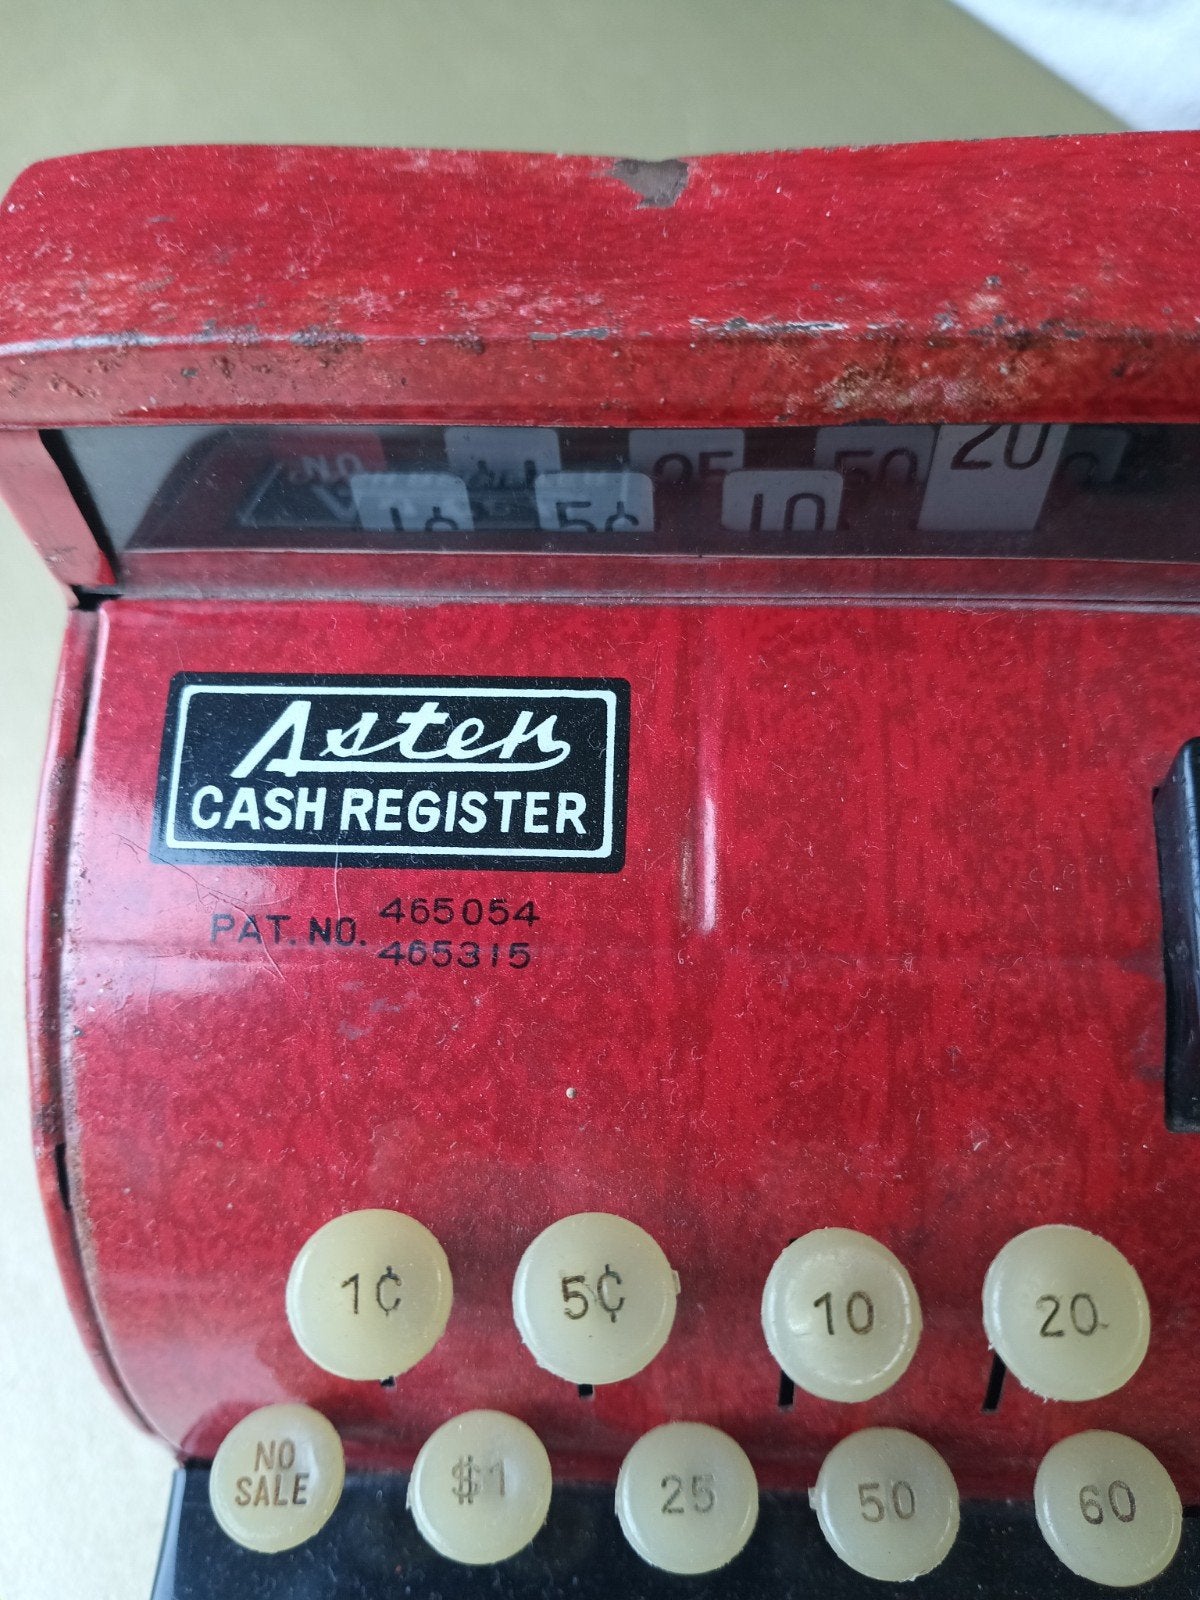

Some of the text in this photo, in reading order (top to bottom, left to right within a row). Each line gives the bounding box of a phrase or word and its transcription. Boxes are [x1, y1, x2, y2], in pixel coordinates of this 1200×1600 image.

[191, 785, 587, 835] CASH REGISTER
[211, 914, 367, 948] PAT. NO.
[379, 898, 540, 927] 465054
[377, 940, 531, 970] 465315
[560, 1263, 626, 1323] 5¢
[813, 1290, 875, 1335] 10
[254, 1439, 296, 1472] NO
[235, 1473, 309, 1507] SALE
[451, 1456, 506, 1504] $1
[660, 1474, 715, 1514] 25
[858, 1480, 916, 1523] 50
[1078, 1480, 1137, 1525] 60
